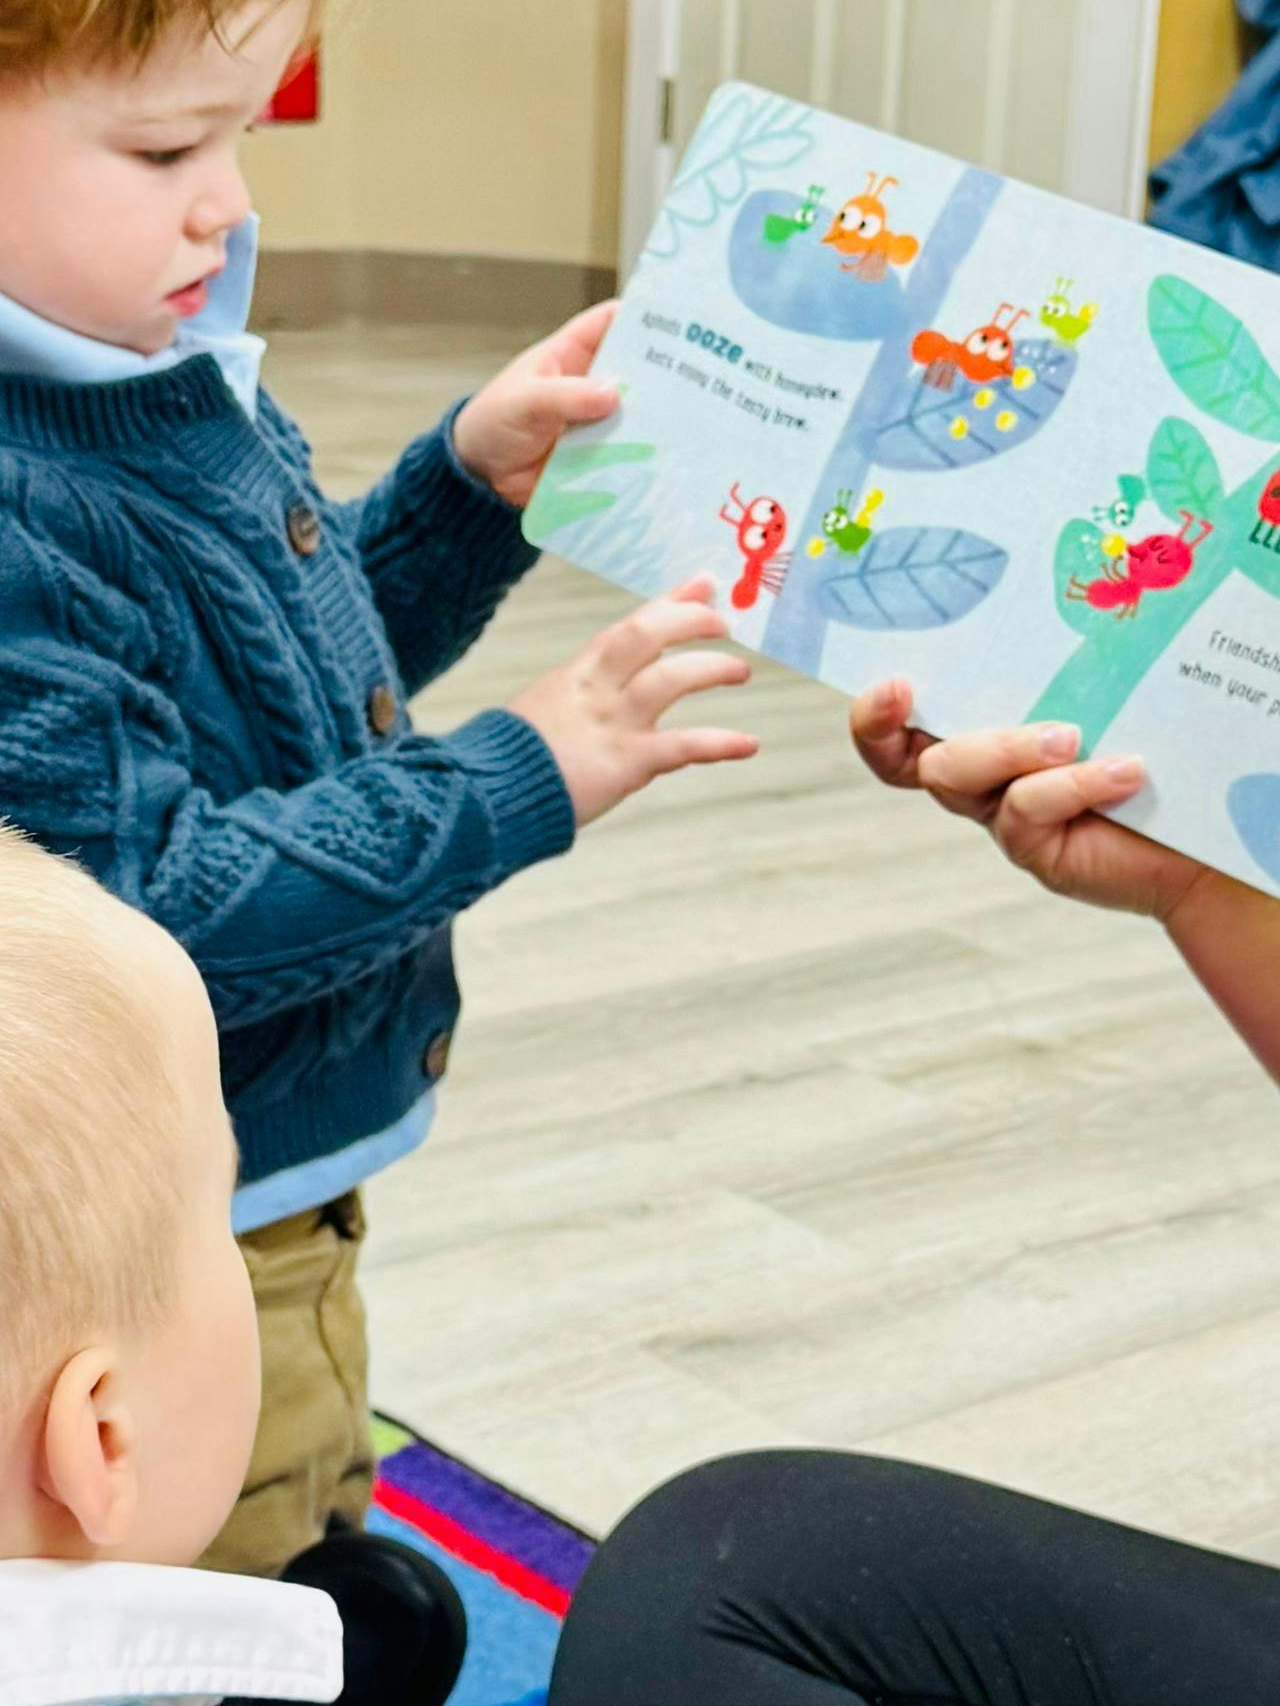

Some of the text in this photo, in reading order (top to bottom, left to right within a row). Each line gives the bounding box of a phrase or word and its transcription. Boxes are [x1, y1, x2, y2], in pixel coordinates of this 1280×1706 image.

[711, 376, 734, 401] the
[1178, 660, 1223, 688] when
[1226, 677, 1268, 705] your
